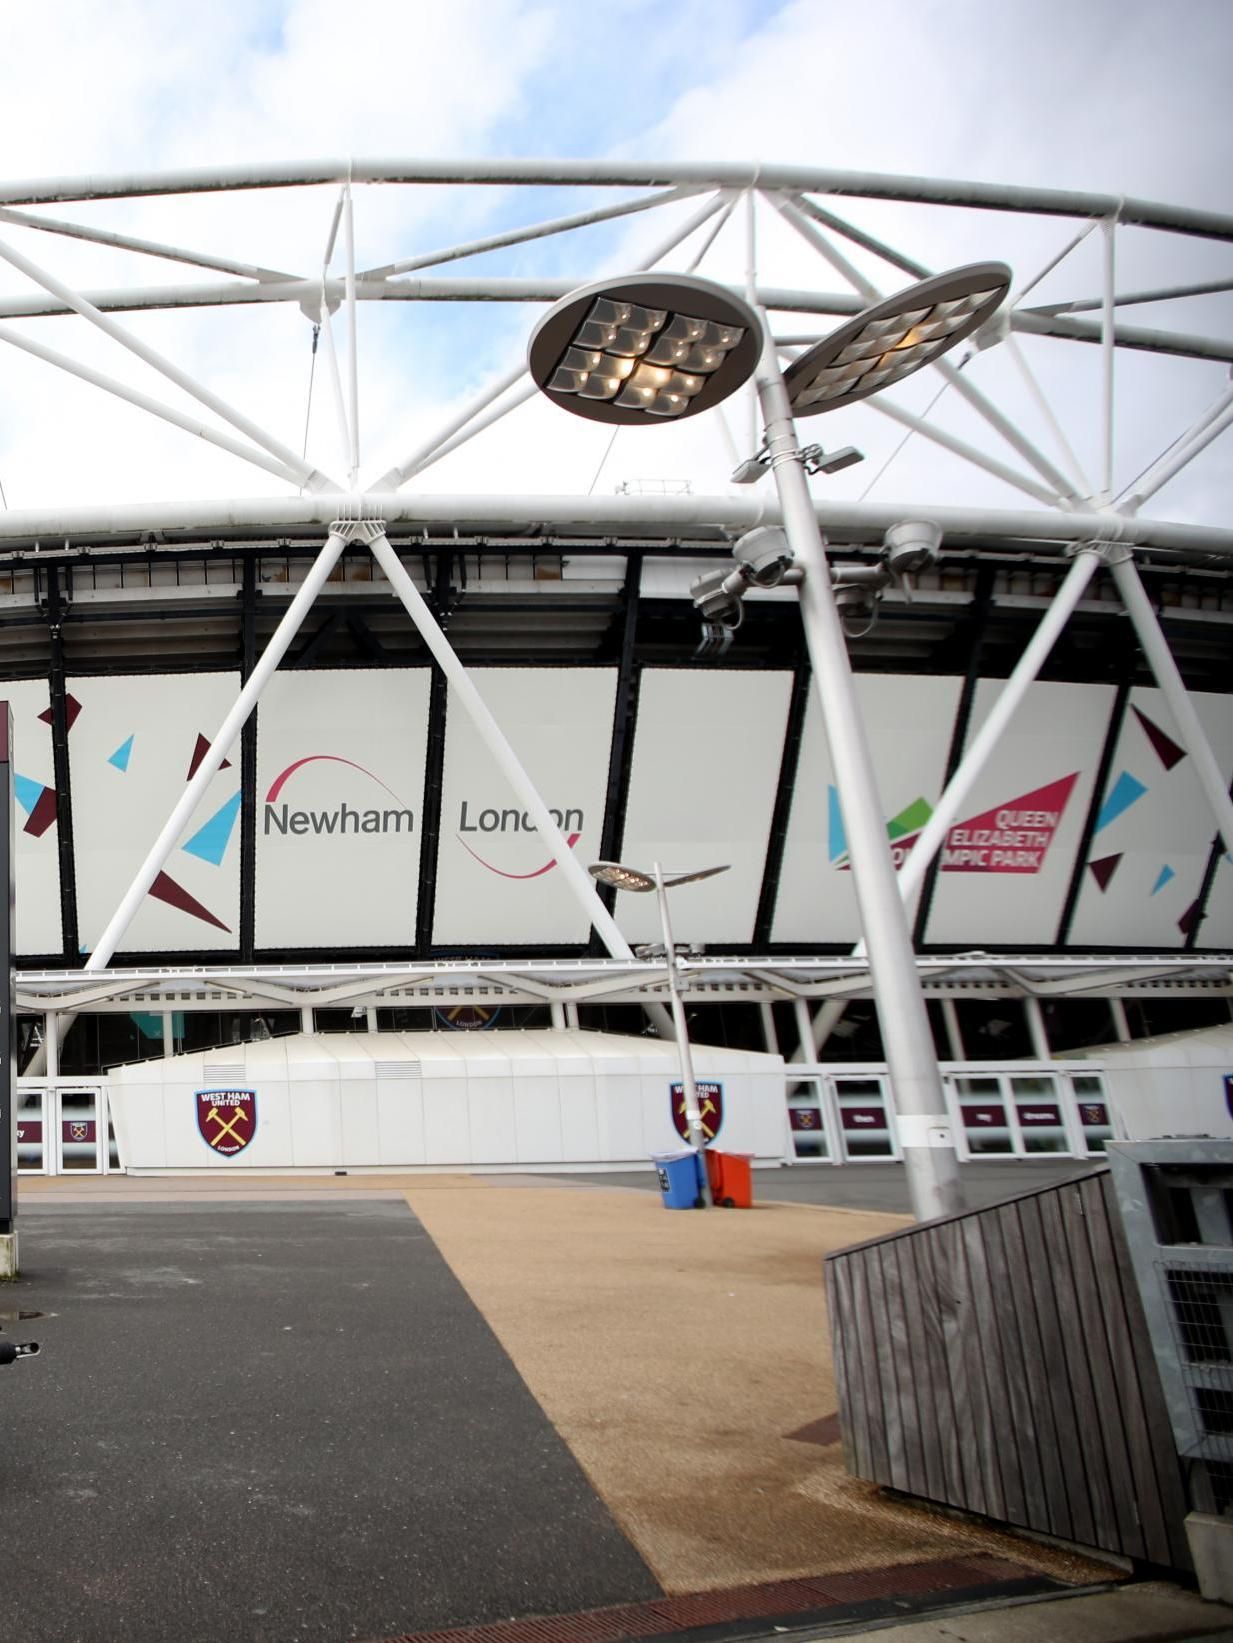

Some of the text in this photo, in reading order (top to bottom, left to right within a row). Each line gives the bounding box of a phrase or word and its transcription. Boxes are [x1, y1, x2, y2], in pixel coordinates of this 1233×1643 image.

[264, 802, 414, 835] Newham
[995, 810, 1059, 829] QUEEN
[950, 829, 1050, 847] ELIZABETH
[991, 850, 1043, 867] PARK
[201, 1092, 250, 1102] WEST HAM
